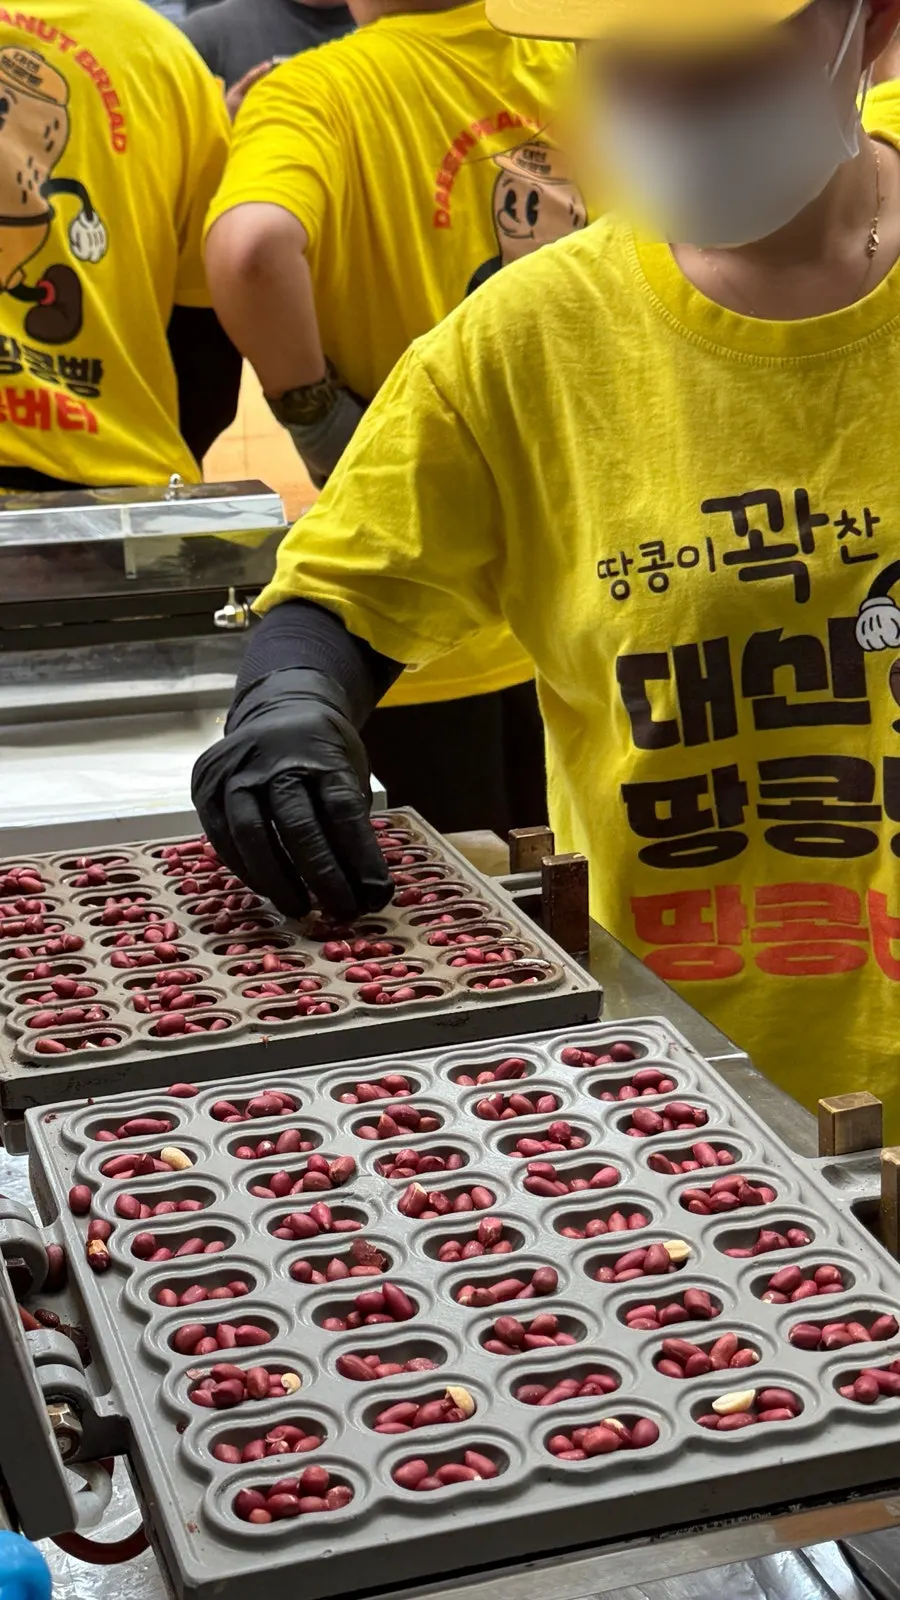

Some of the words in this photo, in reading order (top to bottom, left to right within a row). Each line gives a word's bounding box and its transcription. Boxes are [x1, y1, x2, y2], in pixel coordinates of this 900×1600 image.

[75, 50, 126, 152] BREAD
[0, 386, 98, 434] 버터
[616, 616, 871, 749] 대신
